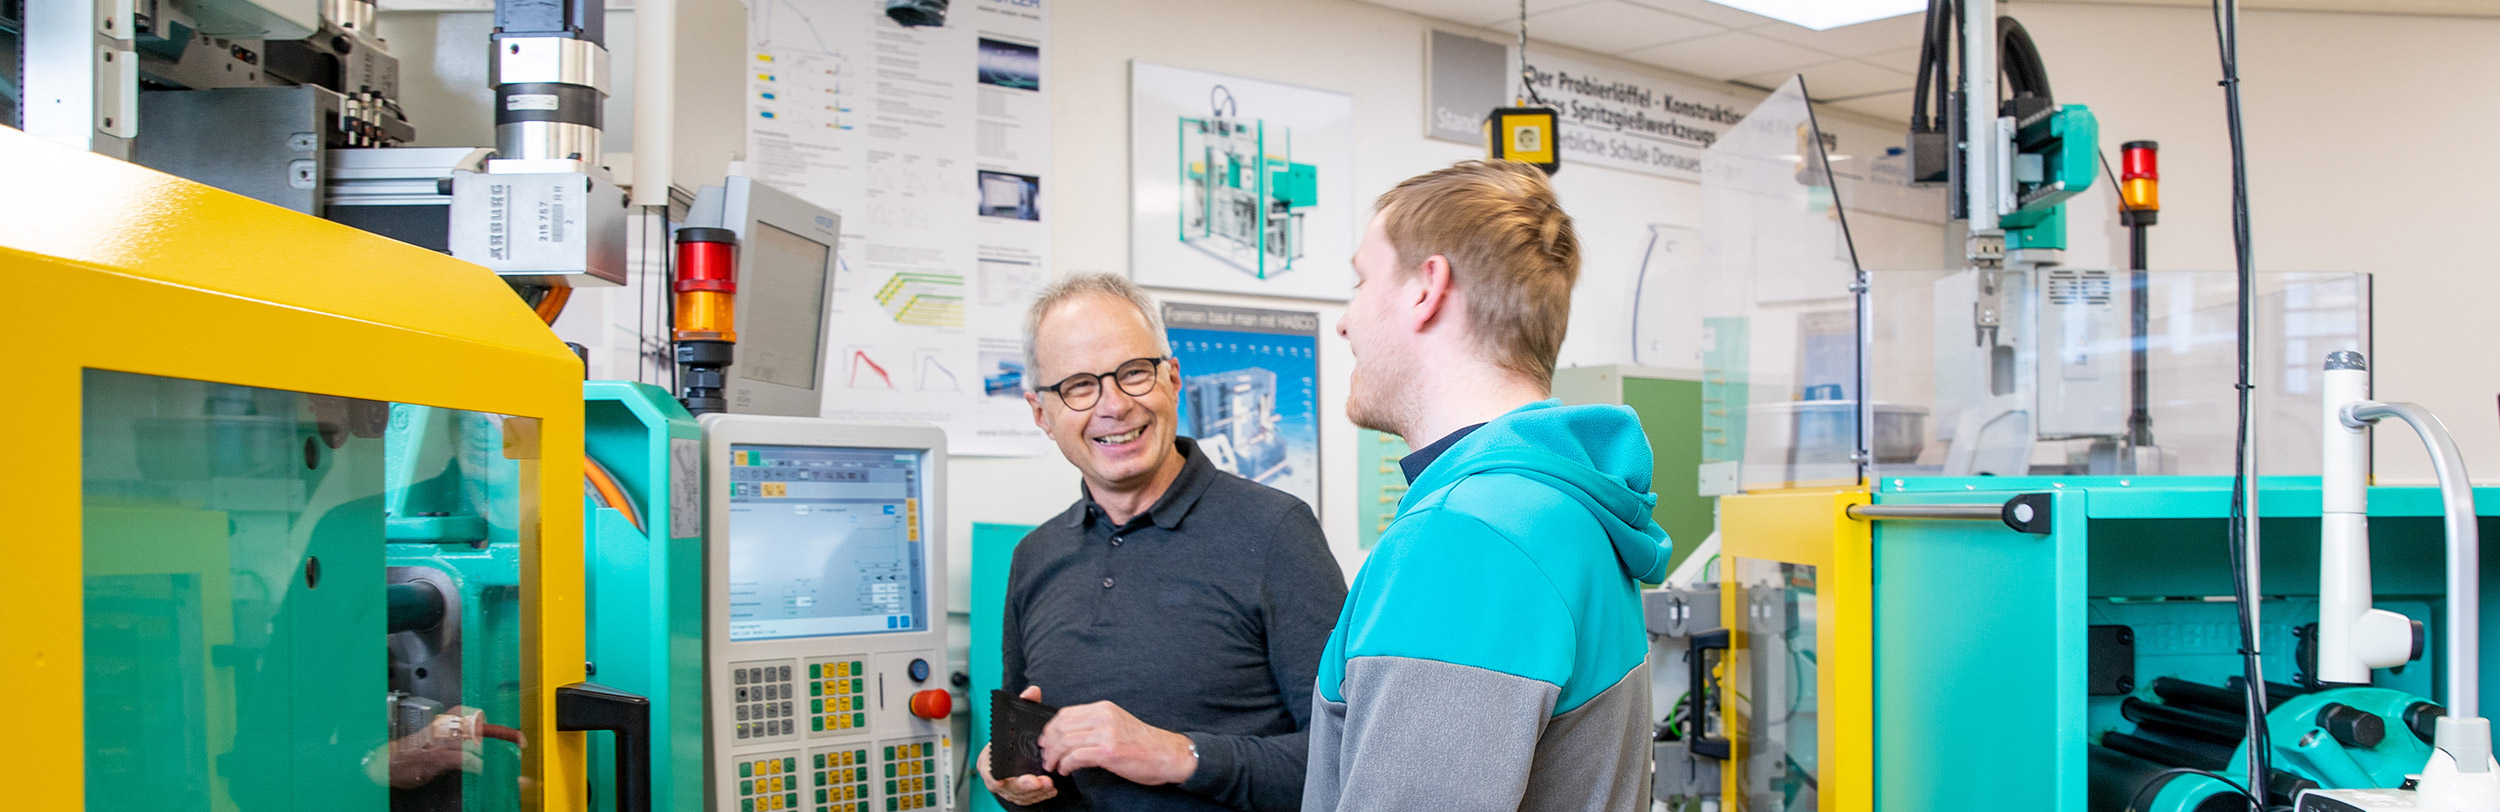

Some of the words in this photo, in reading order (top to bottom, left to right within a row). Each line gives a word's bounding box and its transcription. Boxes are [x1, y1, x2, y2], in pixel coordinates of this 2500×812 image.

[1524, 65, 1554, 88] Der
[1559, 70, 1651, 109] Probierlöffel
[1608, 136, 1649, 164] Schule
[490, 184, 502, 260] ARBURG
[1276, 314, 1318, 331] HASCO
